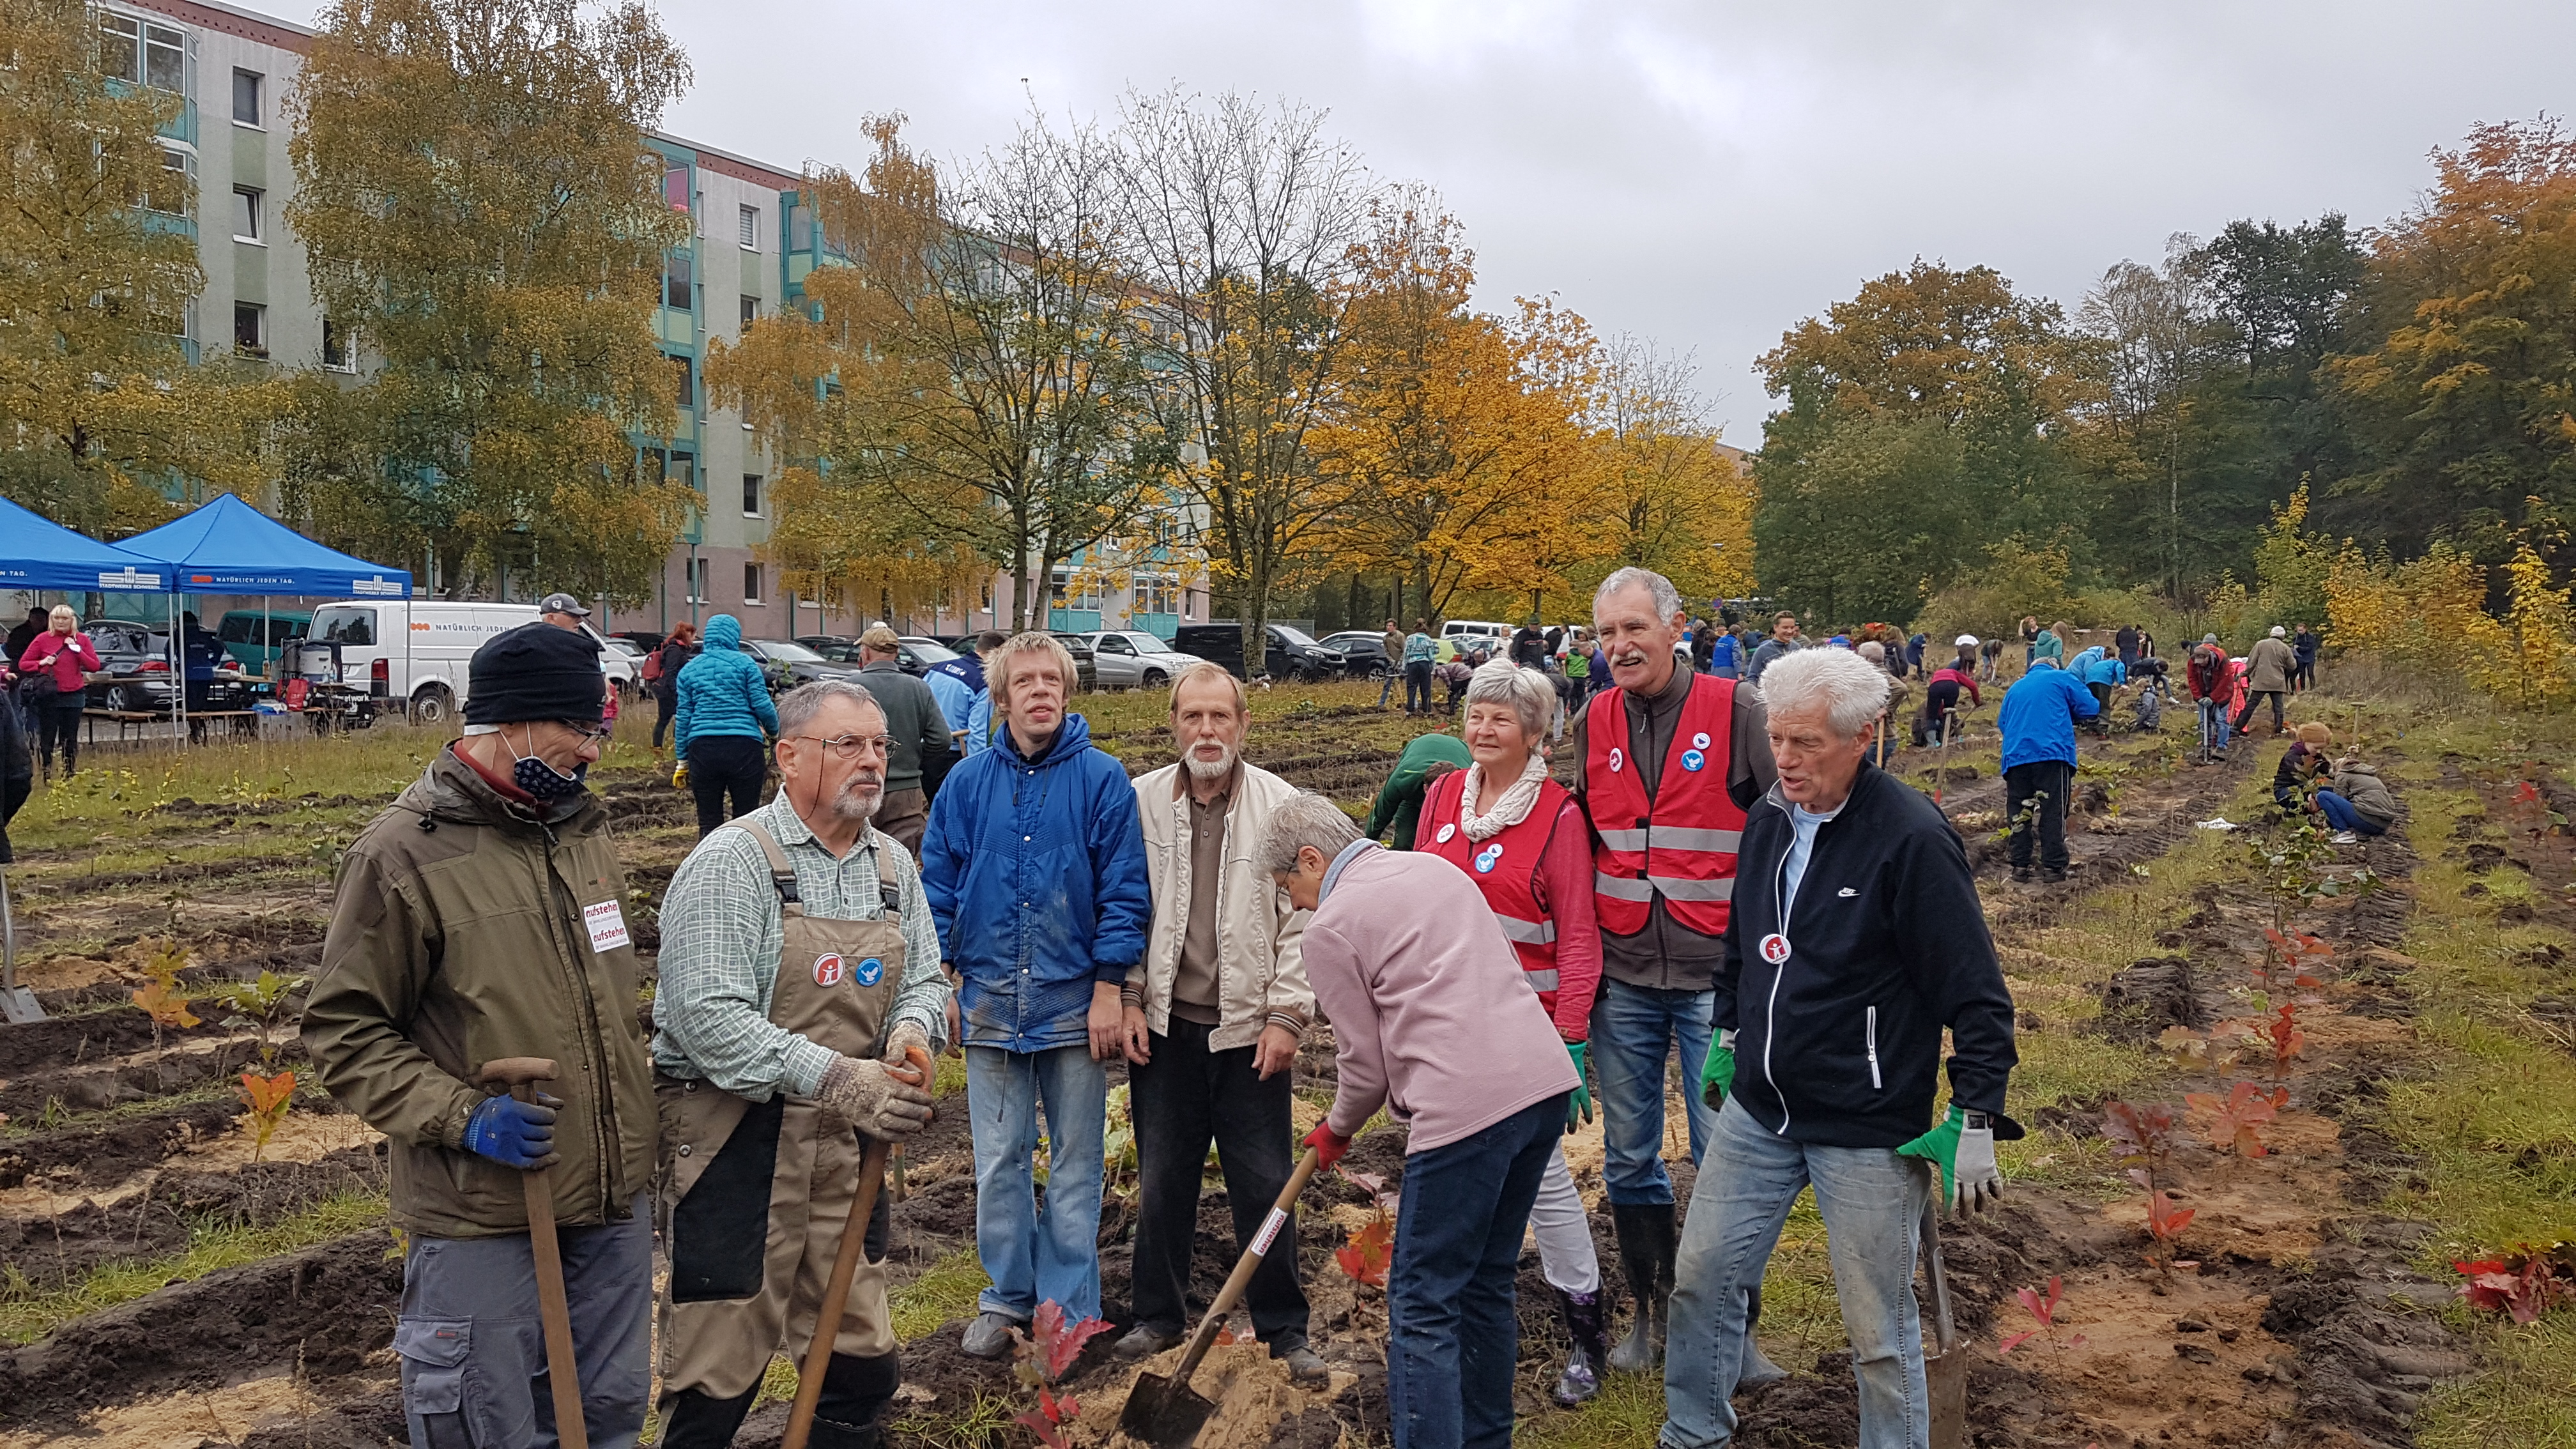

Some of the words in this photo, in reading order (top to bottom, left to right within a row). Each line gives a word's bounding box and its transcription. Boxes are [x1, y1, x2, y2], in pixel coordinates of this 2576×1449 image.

[435, 623, 482, 631] NATÜRLICH
[585, 902, 618, 918] aufstehen
[593, 926, 626, 942] aufstehen
[1259, 1215, 1285, 1254] aufstehen
